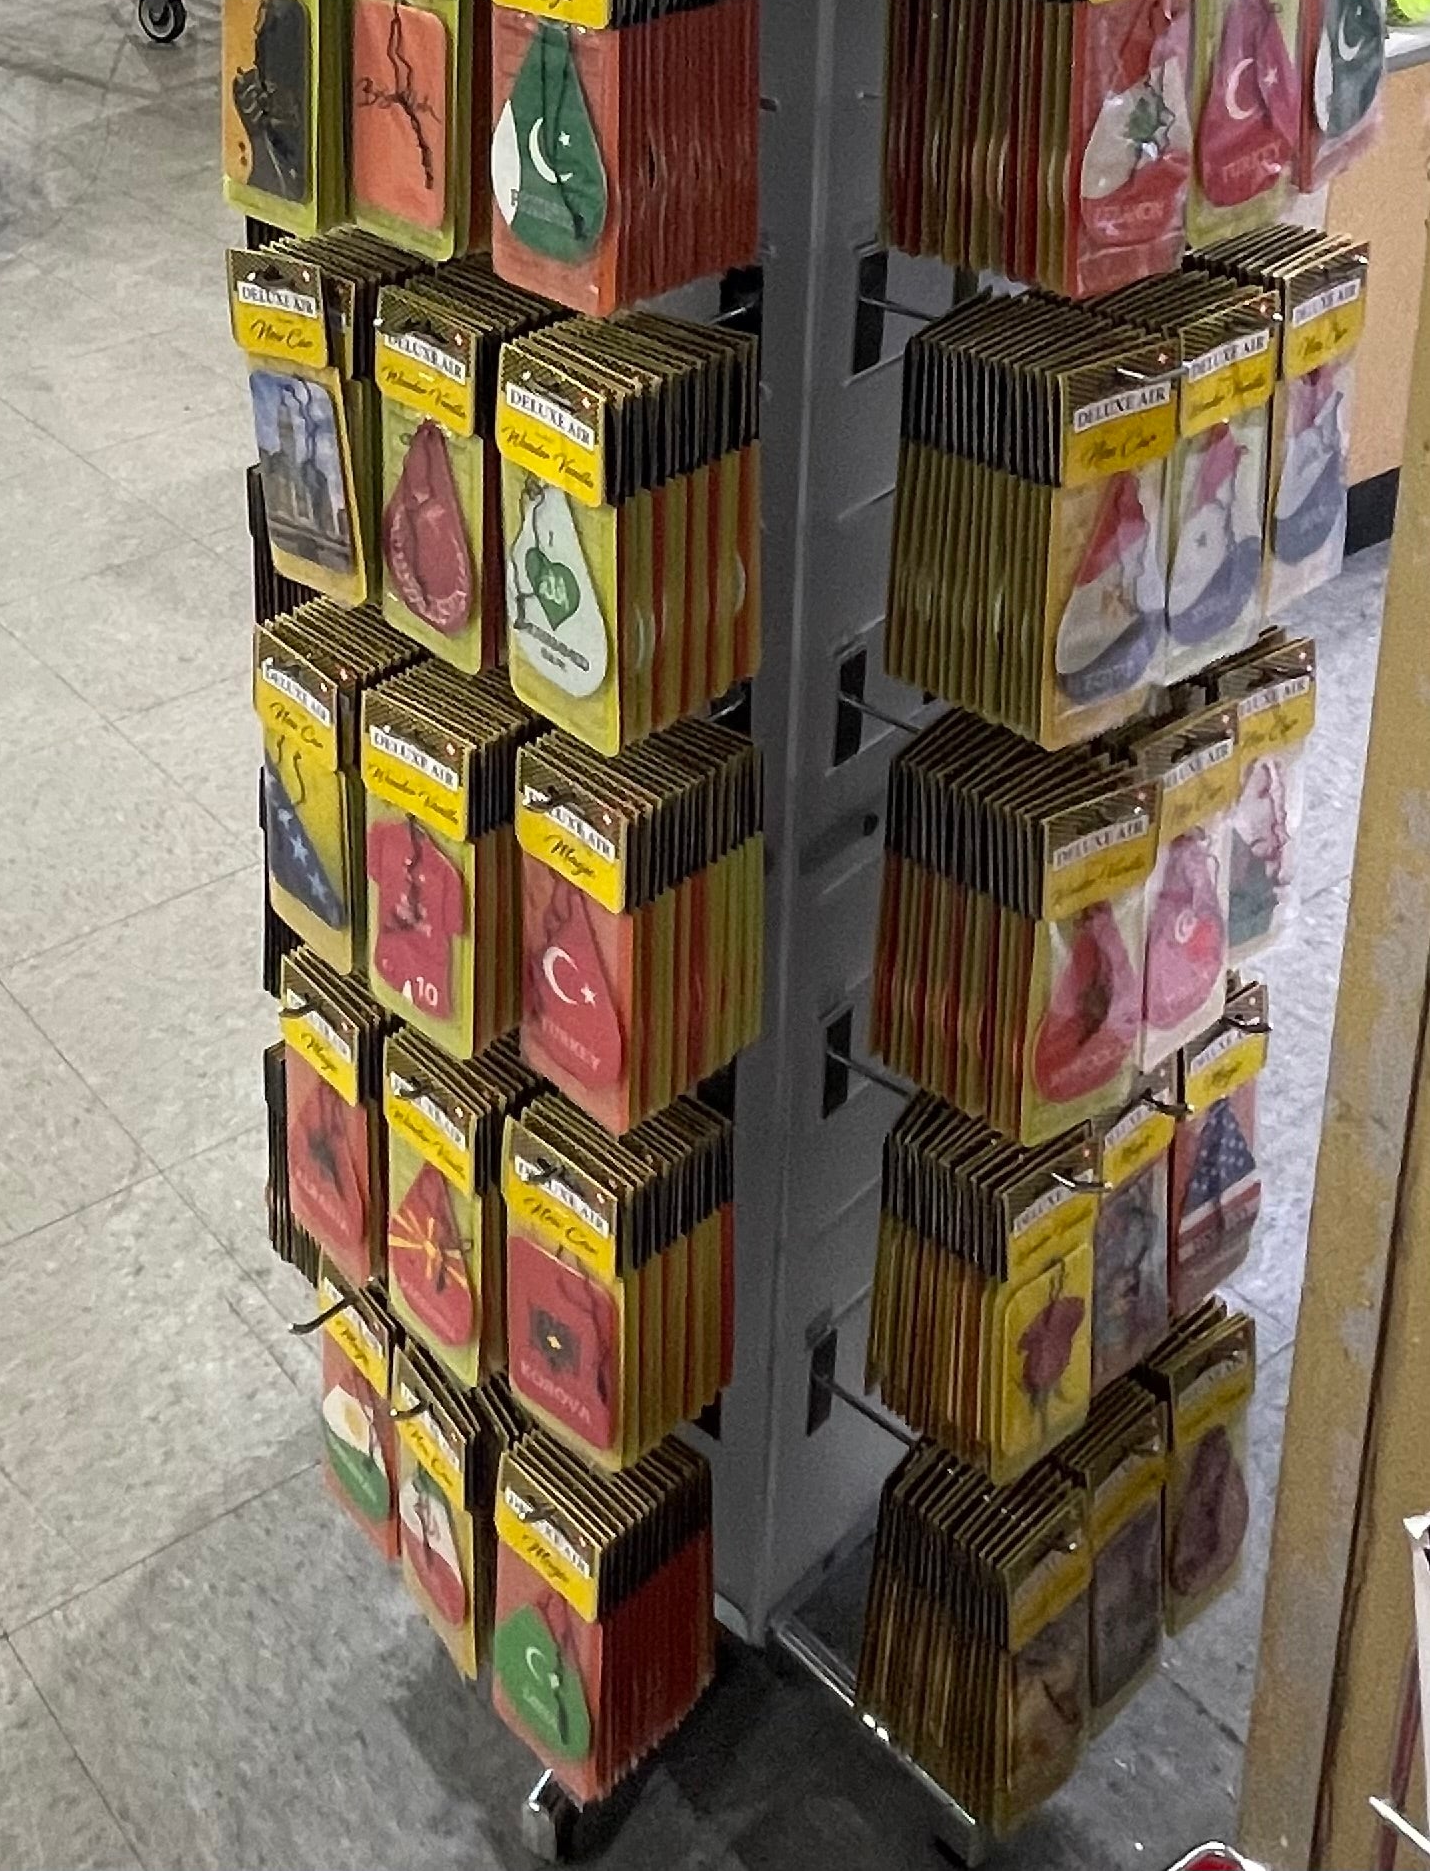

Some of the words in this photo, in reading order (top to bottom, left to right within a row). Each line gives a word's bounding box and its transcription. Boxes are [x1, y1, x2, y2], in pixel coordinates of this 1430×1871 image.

[240, 285, 289, 310] DELUXE
[290, 295, 316, 316] AIR
[250, 317, 285, 343] New
[286, 328, 315, 349] Car
[386, 334, 437, 366] DELUXE
[438, 354, 464, 382] AIR
[509, 388, 566, 430] DELUXE
[566, 417, 592, 447] AIR
[1077, 391, 1136, 429] DELUXE
[1138, 385, 1167, 407] AIR
[373, 732, 430, 771] DELUXE
[431, 763, 455, 788] AIR
[415, 976, 439, 1007] 10
